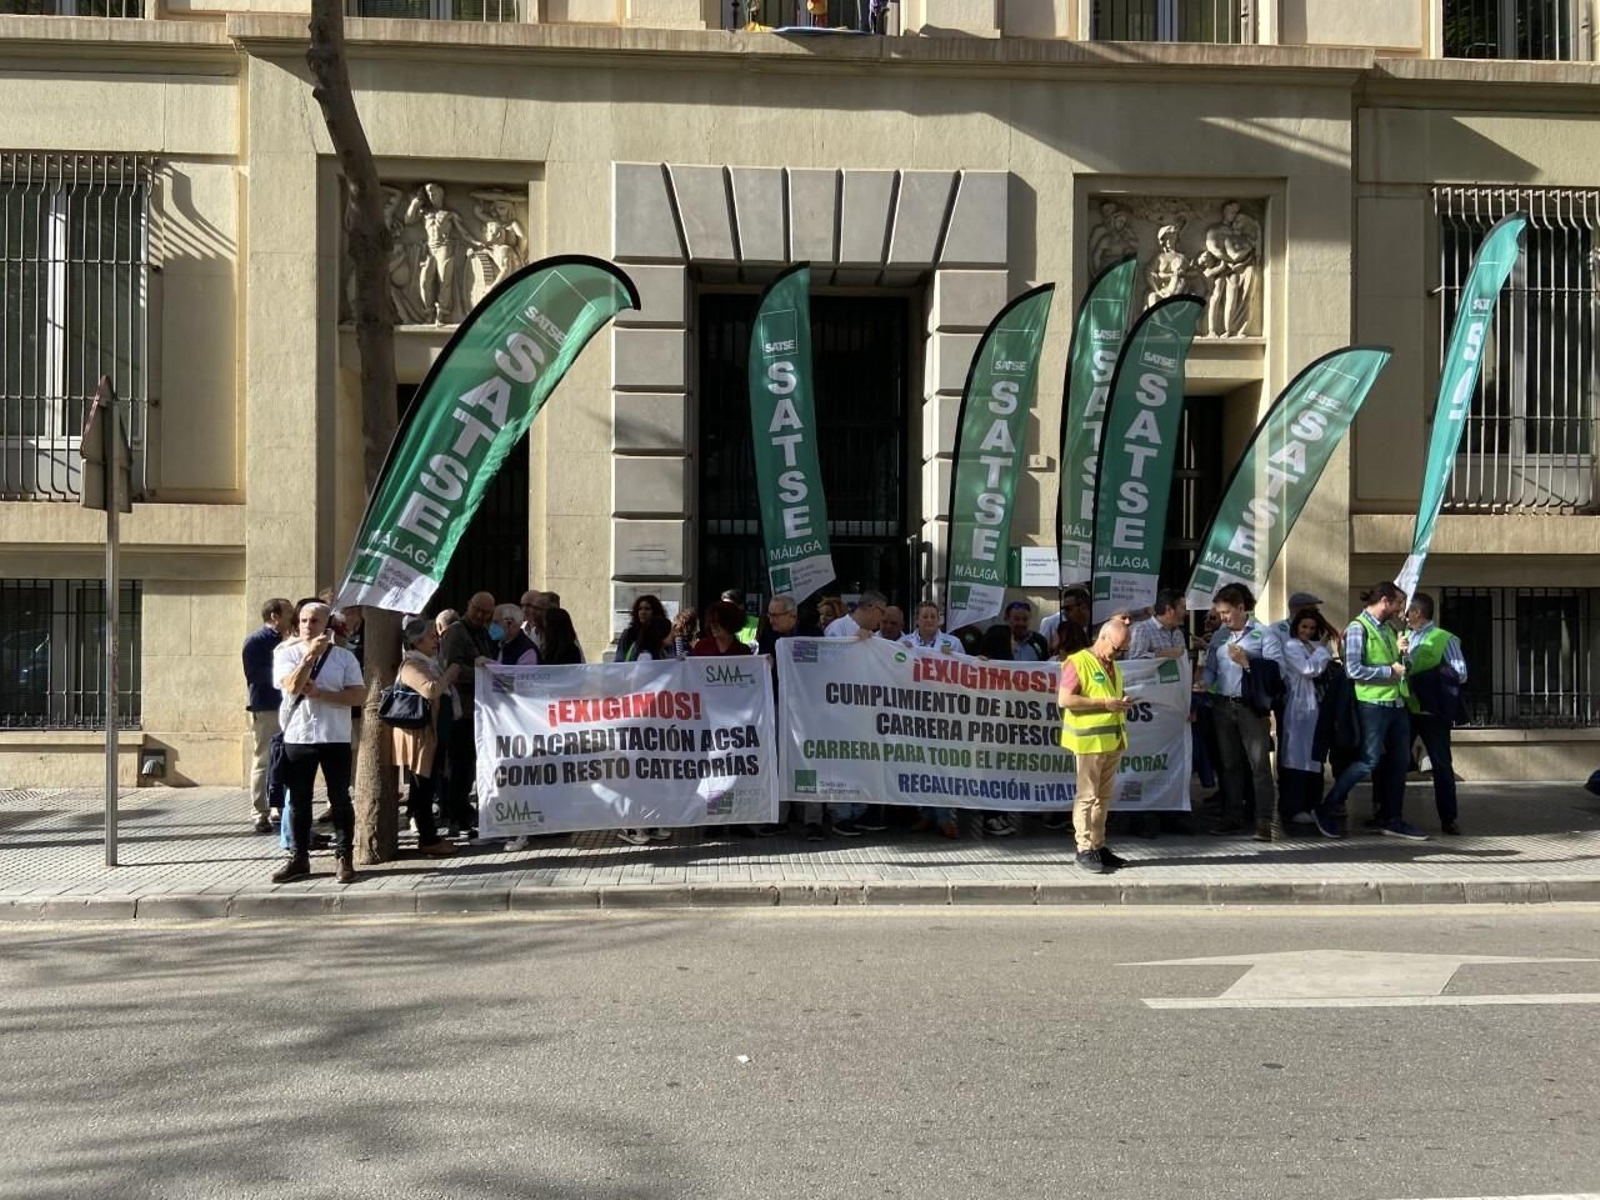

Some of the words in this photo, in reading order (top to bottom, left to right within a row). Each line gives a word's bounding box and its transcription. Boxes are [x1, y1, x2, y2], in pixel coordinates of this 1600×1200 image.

[765, 340, 796, 352] SATSE
[1144, 351, 1178, 369] SATSE
[995, 360, 1027, 371] SATSE
[397, 332, 545, 545] SATSE
[767, 361, 812, 540] SATSE
[972, 381, 1019, 561] SATSE
[1112, 373, 1169, 550] SATSE
[1228, 410, 1328, 560] SATSE
[770, 540, 822, 561] MÁLAGA
[706, 665, 748, 685] SMA
[913, 658, 1057, 694] ¡EXIGIMOS!
[548, 690, 702, 728] ¡EXIGIMOS!
[826, 682, 971, 715] CUMPLIMIENTO
[975, 697, 1001, 717] DE
[1005, 700, 1042, 720] LOS
[496, 735, 527, 758] NO
[532, 725, 696, 756] ACREDITACIÓN
[700, 725, 760, 752] ACSA
[876, 712, 963, 741] CARRERA
[968, 721, 1062, 747] PROFESIO
[494, 763, 557, 788] COMO
[563, 757, 630, 784] RESTO
[636, 752, 760, 780] CATEGORÍAS
[803, 739, 880, 760] CARRERA
[883, 743, 926, 764] PARA
[928, 747, 972, 768] TODO
[976, 750, 993, 769] EL
[996, 751, 1076, 773] PERSONA
[898, 773, 1031, 801] RECALIFICACIÓN
